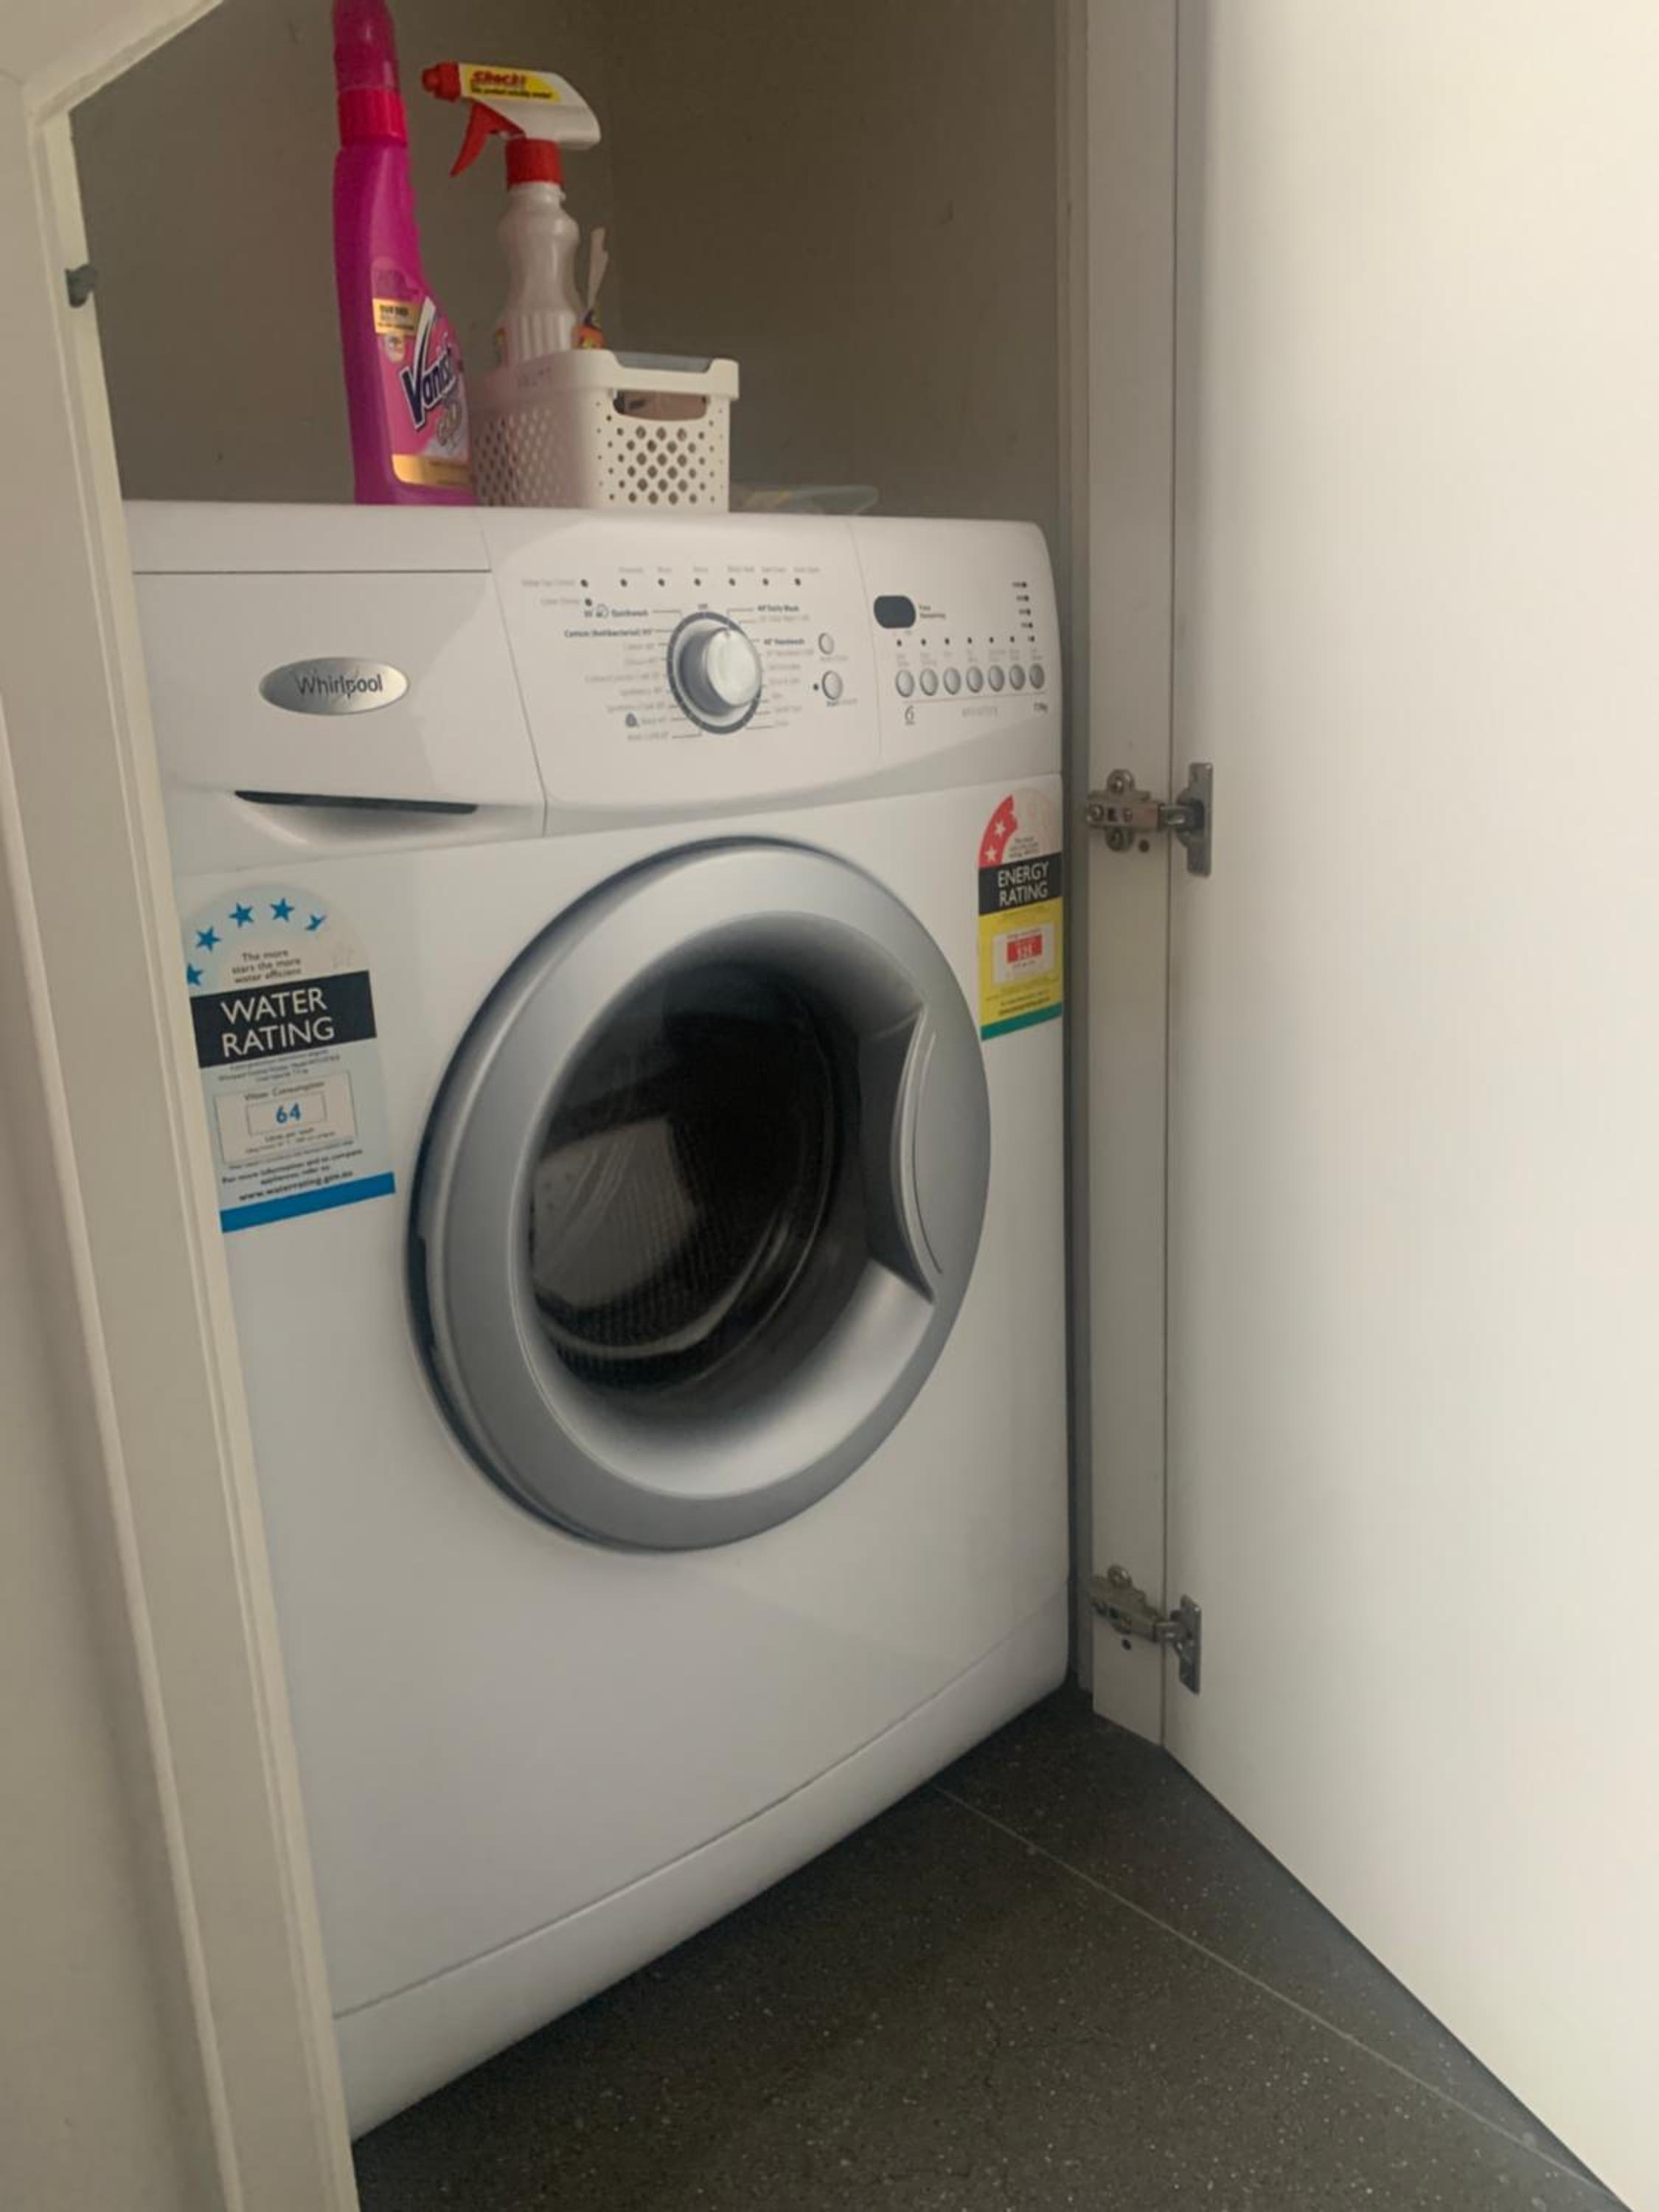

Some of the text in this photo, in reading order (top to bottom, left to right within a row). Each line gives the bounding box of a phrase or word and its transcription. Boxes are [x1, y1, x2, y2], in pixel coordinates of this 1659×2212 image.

[295, 673, 383, 699] Whirlpool
[998, 861, 1049, 888] ENERGY
[999, 880, 1048, 907] RATING
[232, 958, 302, 974] stars the more
[242, 949, 289, 961] The more
[234, 967, 302, 984] water efficient
[220, 987, 328, 1024] WATER
[222, 1016, 335, 1057] RATING
[275, 1102, 302, 1124] 64
